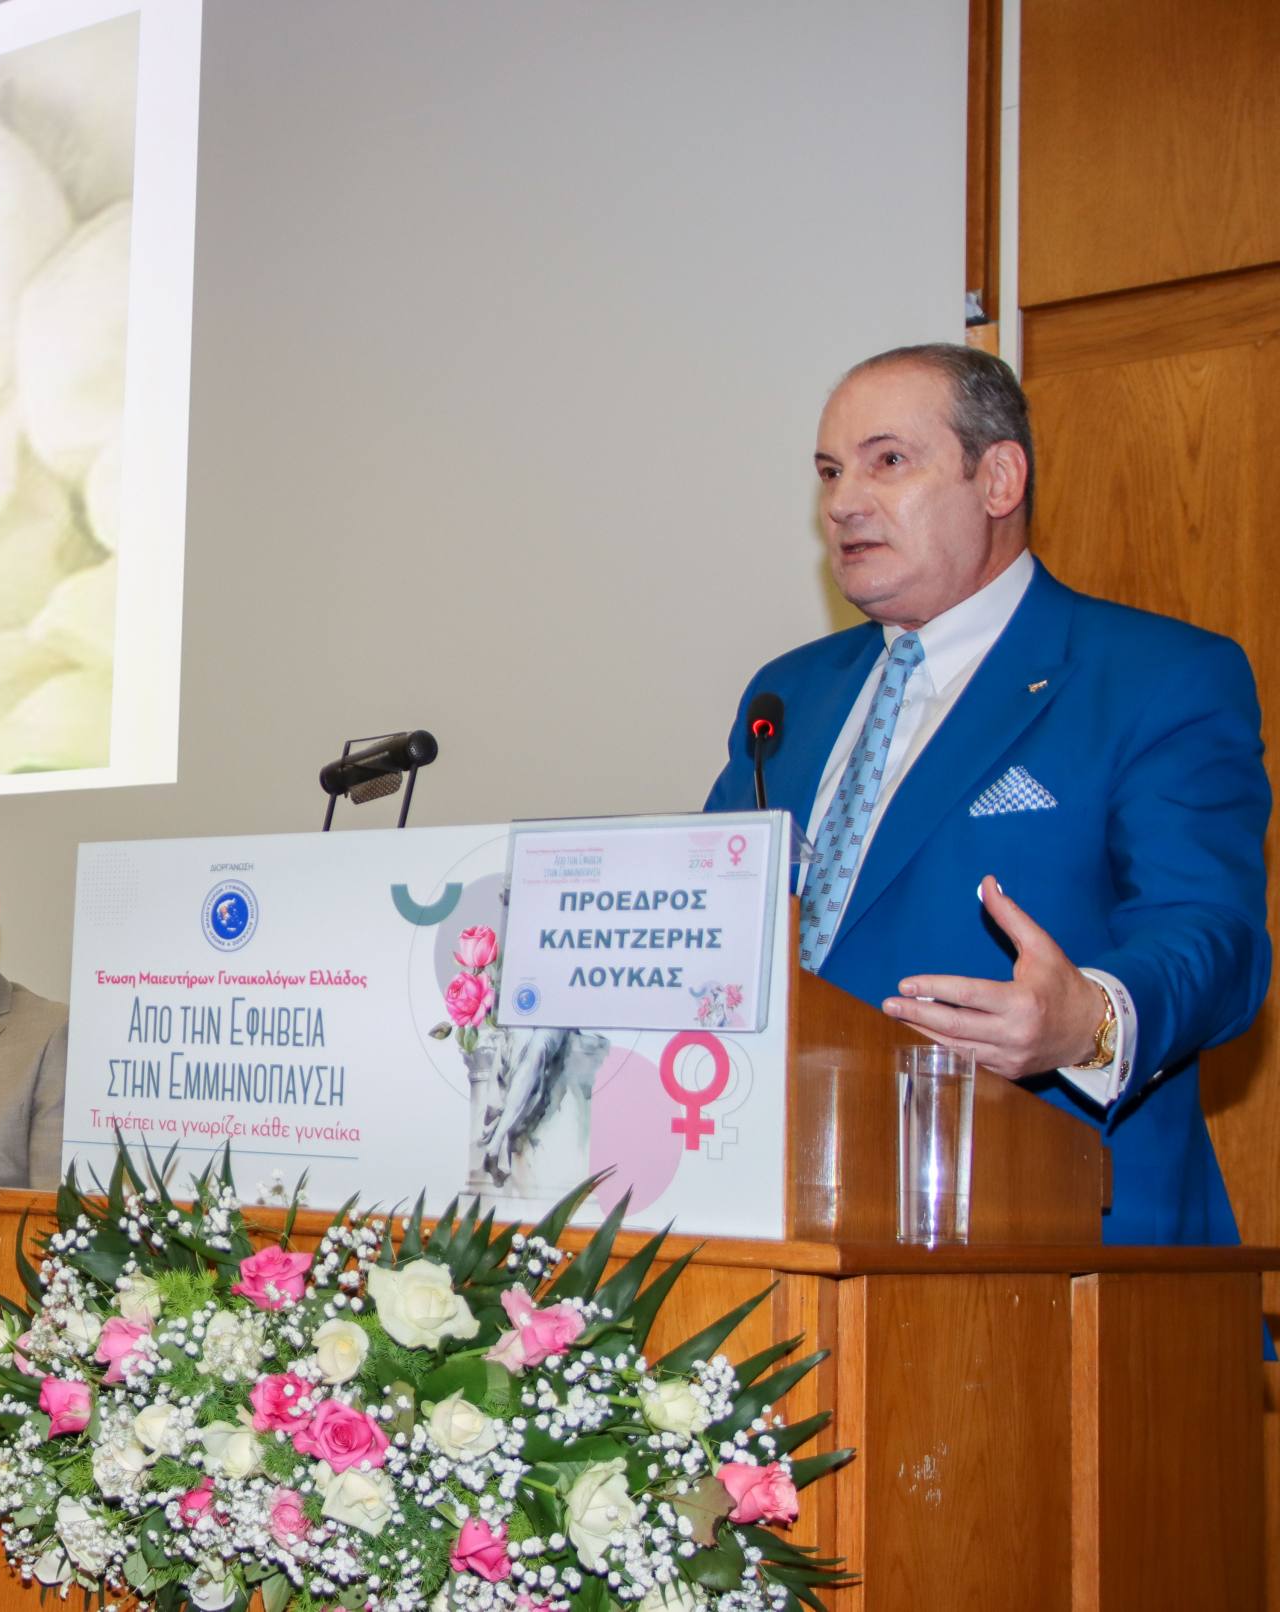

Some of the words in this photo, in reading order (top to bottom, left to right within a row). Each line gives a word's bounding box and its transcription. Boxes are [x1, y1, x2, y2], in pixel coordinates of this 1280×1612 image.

[559, 889, 708, 912] ΠΡΟΕΔΡΟΣ
[538, 928, 723, 950] ΚΛΕΝΤΖΕΡΗΣ
[95, 970, 136, 988] Ένωση
[139, 970, 215, 989] Μαιευτήρων
[218, 970, 306, 989] Γυναικολόγων
[309, 969, 368, 988] Ελλάδος
[568, 966, 684, 988] ΛΟΥΚΑΣ
[89, 1108, 102, 1128] Τι
[158, 1118, 177, 1133] να
[181, 1115, 247, 1138] γνωρίζει
[251, 1116, 290, 1138] κάθε
[295, 1121, 361, 1143] γυναίκα
